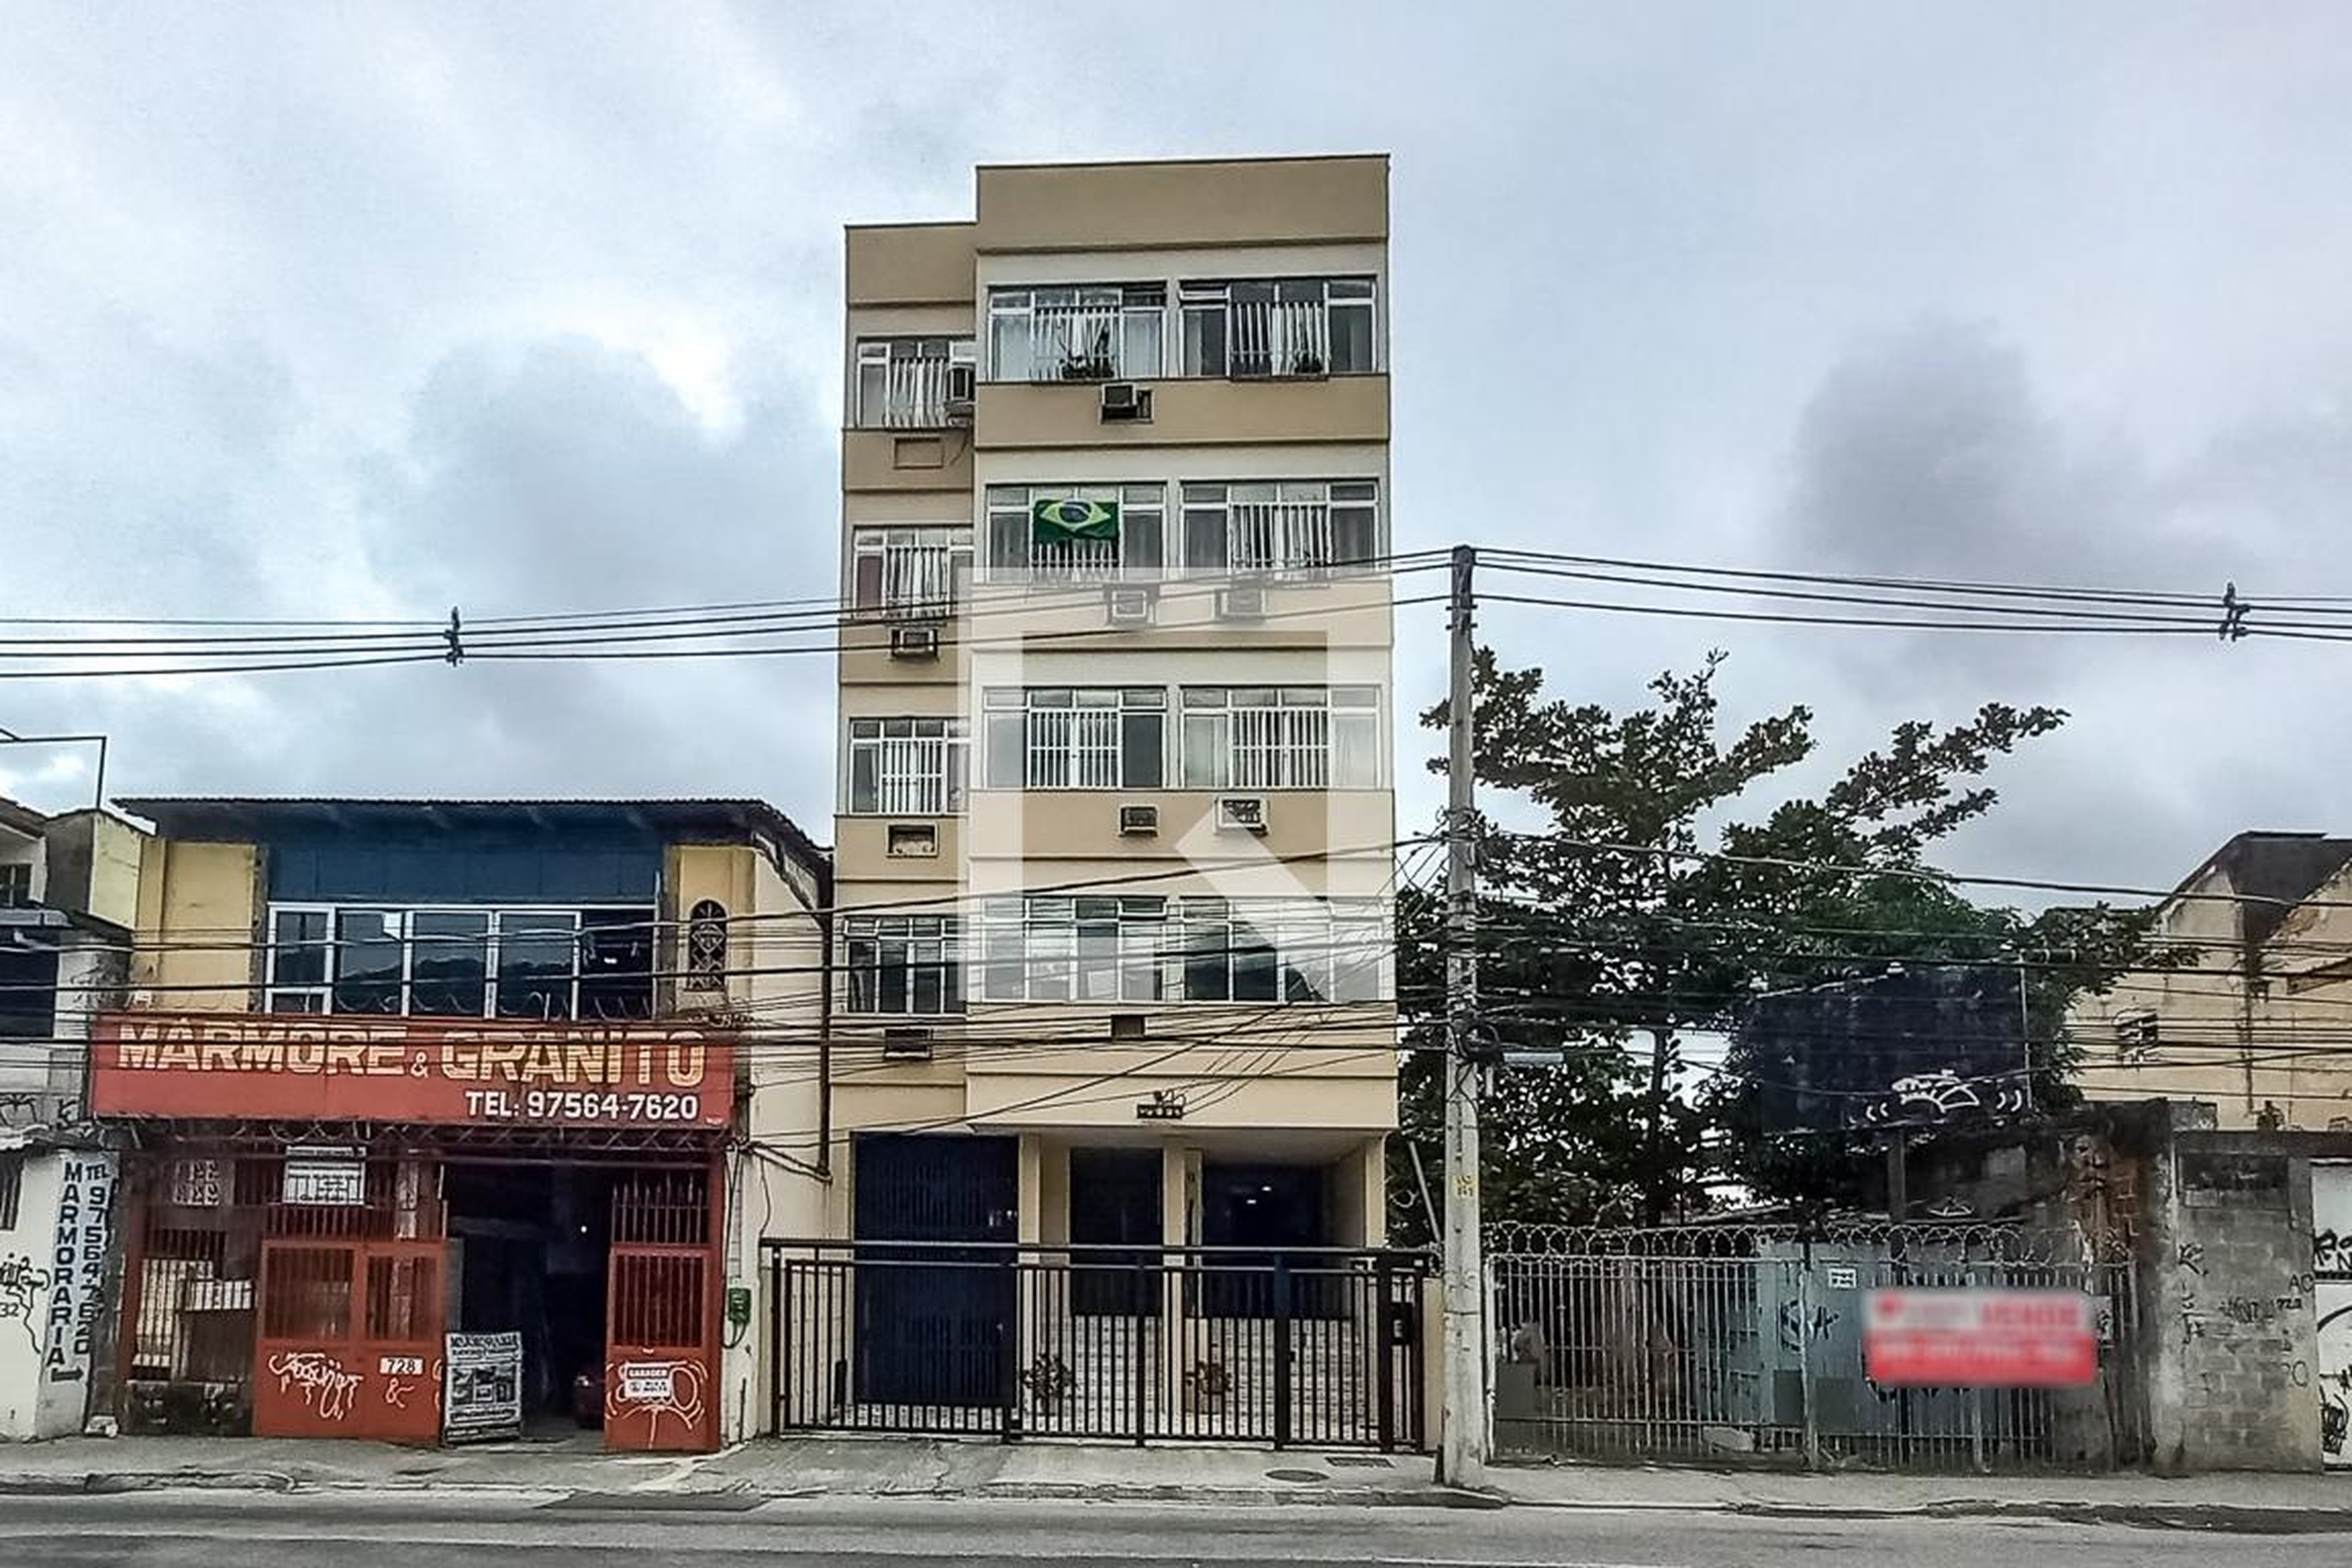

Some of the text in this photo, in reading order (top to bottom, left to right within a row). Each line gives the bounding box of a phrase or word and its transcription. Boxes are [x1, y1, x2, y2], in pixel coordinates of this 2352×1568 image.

[410, 1052, 429, 1078] &
[441, 1031, 706, 1087] GRANITO
[466, 1091, 698, 1120] TEL: 97564-7620
[45, 1162, 83, 1367] MARMORARIA
[388, 1359, 415, 1373] 728
